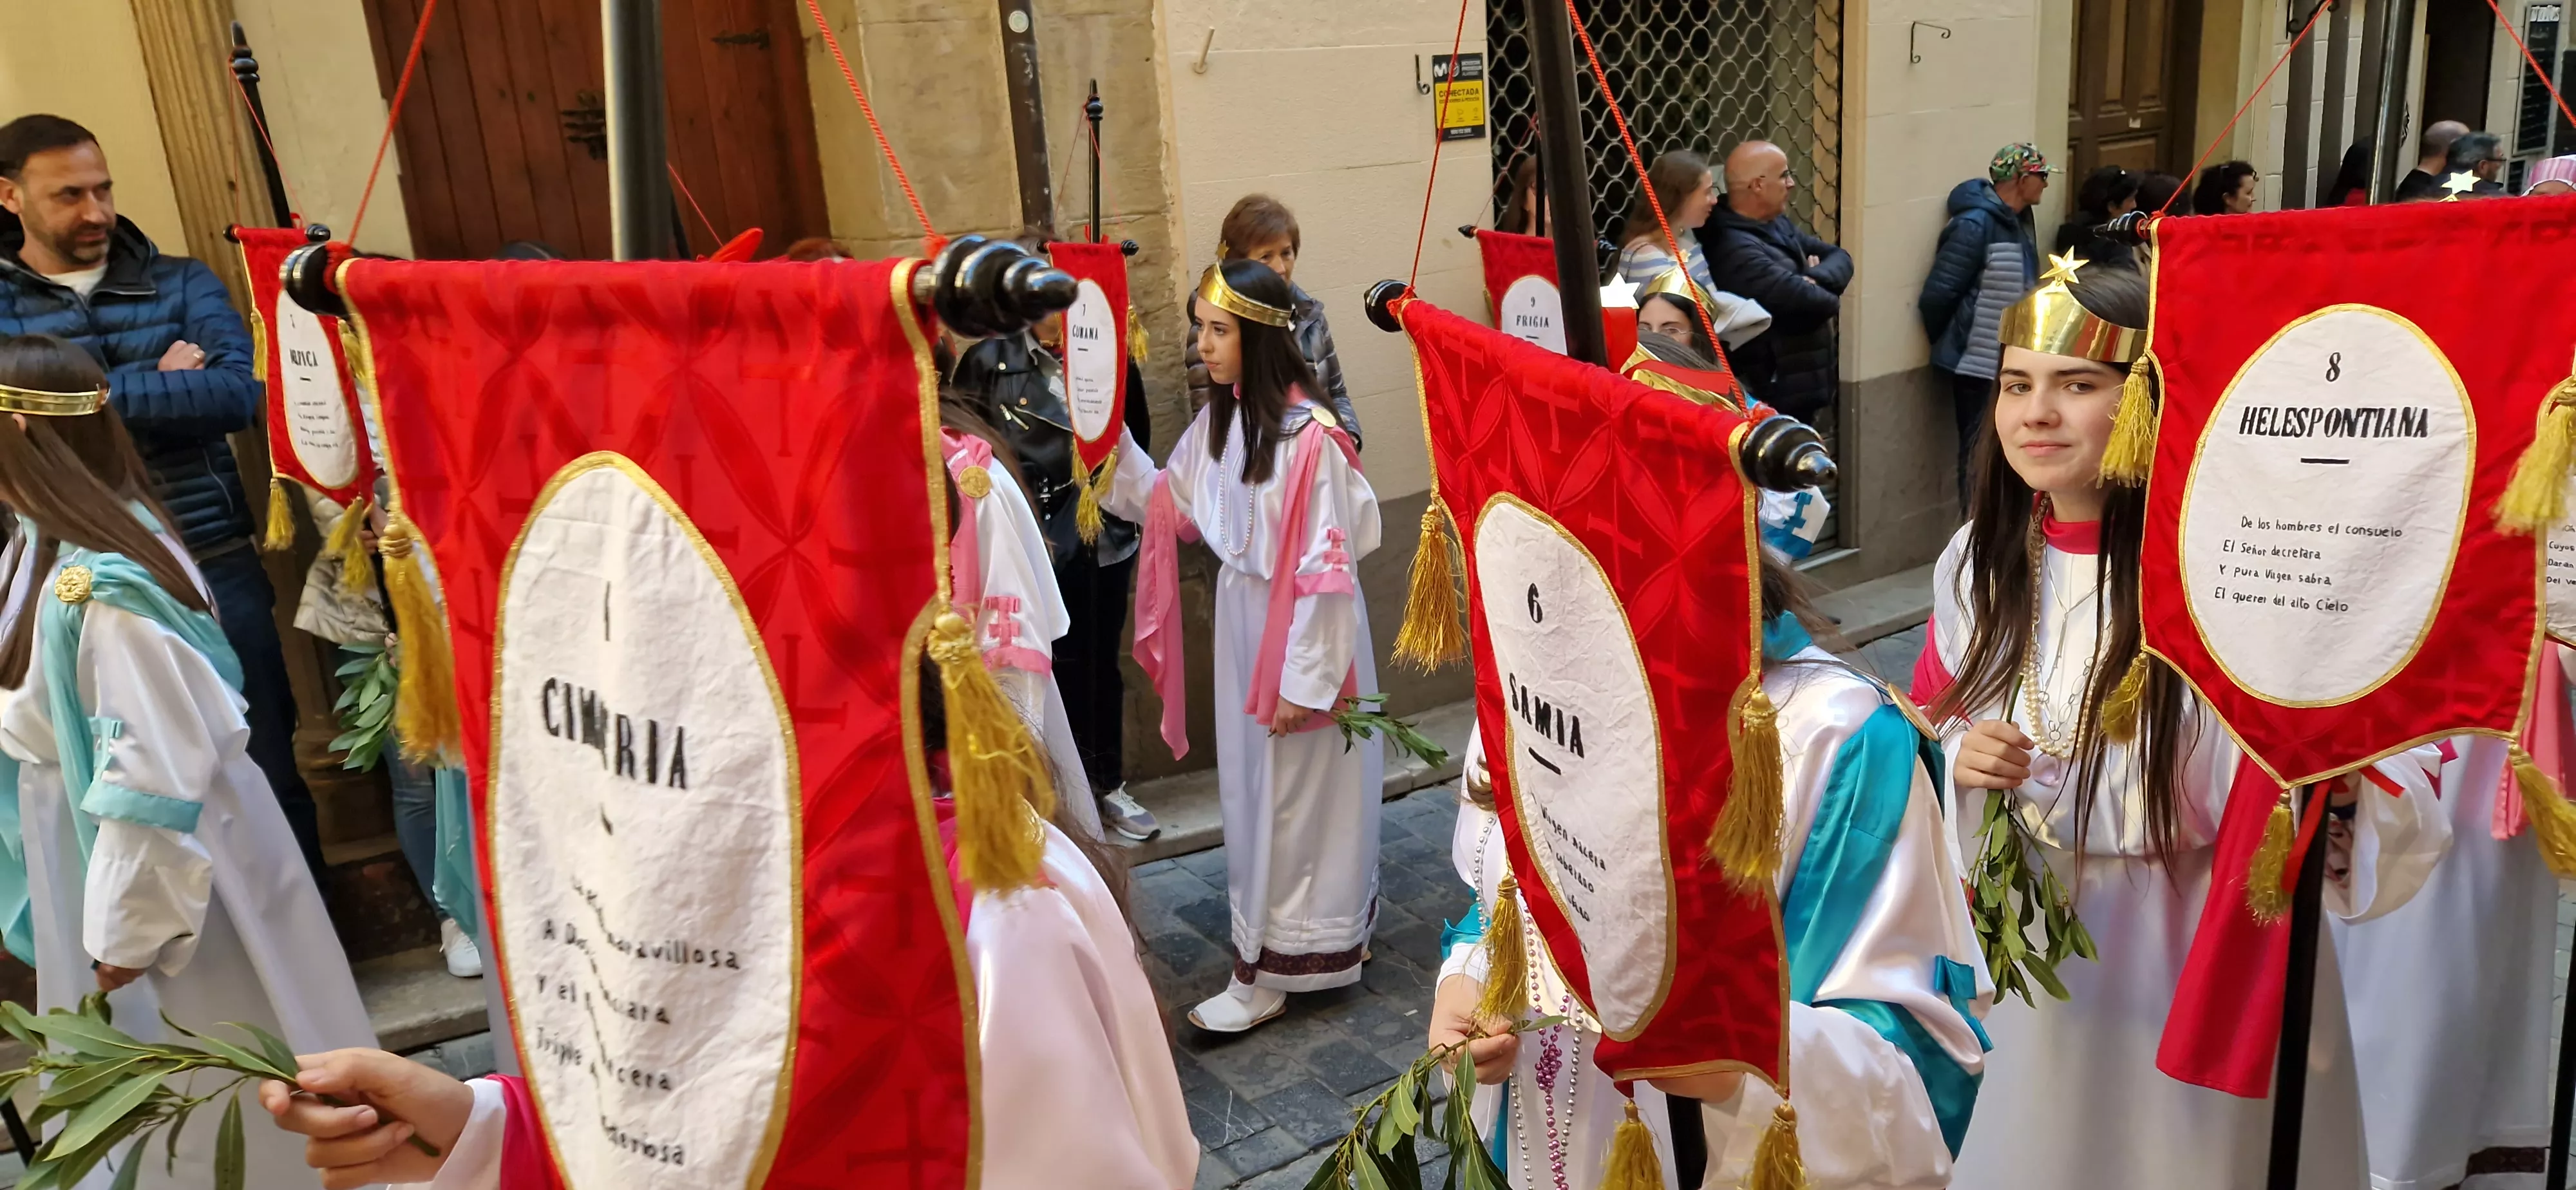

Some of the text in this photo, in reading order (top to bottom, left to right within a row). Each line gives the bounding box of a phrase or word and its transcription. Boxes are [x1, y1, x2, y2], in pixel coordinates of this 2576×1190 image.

[1531, 296, 1535, 308] 9
[1516, 315, 1549, 328] FRIGIA
[2325, 352, 2341, 382] 8
[2239, 406, 2428, 438] HELESPONTIANA
[2241, 516, 2403, 538] De los hombres el consuelo
[2222, 540, 2321, 560] El Señor decretara
[2549, 541, 2575, 551] Cuyos
[2219, 564, 2332, 585] Y pura Virgen sabra
[2548, 558, 2574, 569] Daran
[2546, 576, 2561, 585] Del
[1528, 583, 1542, 623] 6
[2214, 587, 2349, 612] El querer del alto Cielo
[1509, 672, 1584, 759] SAMIA
[542, 677, 687, 790] CIMRIA
[1540, 804, 1606, 871] Virgen nacera
[543, 918, 555, 940] A
[558, 980, 576, 1003] el
